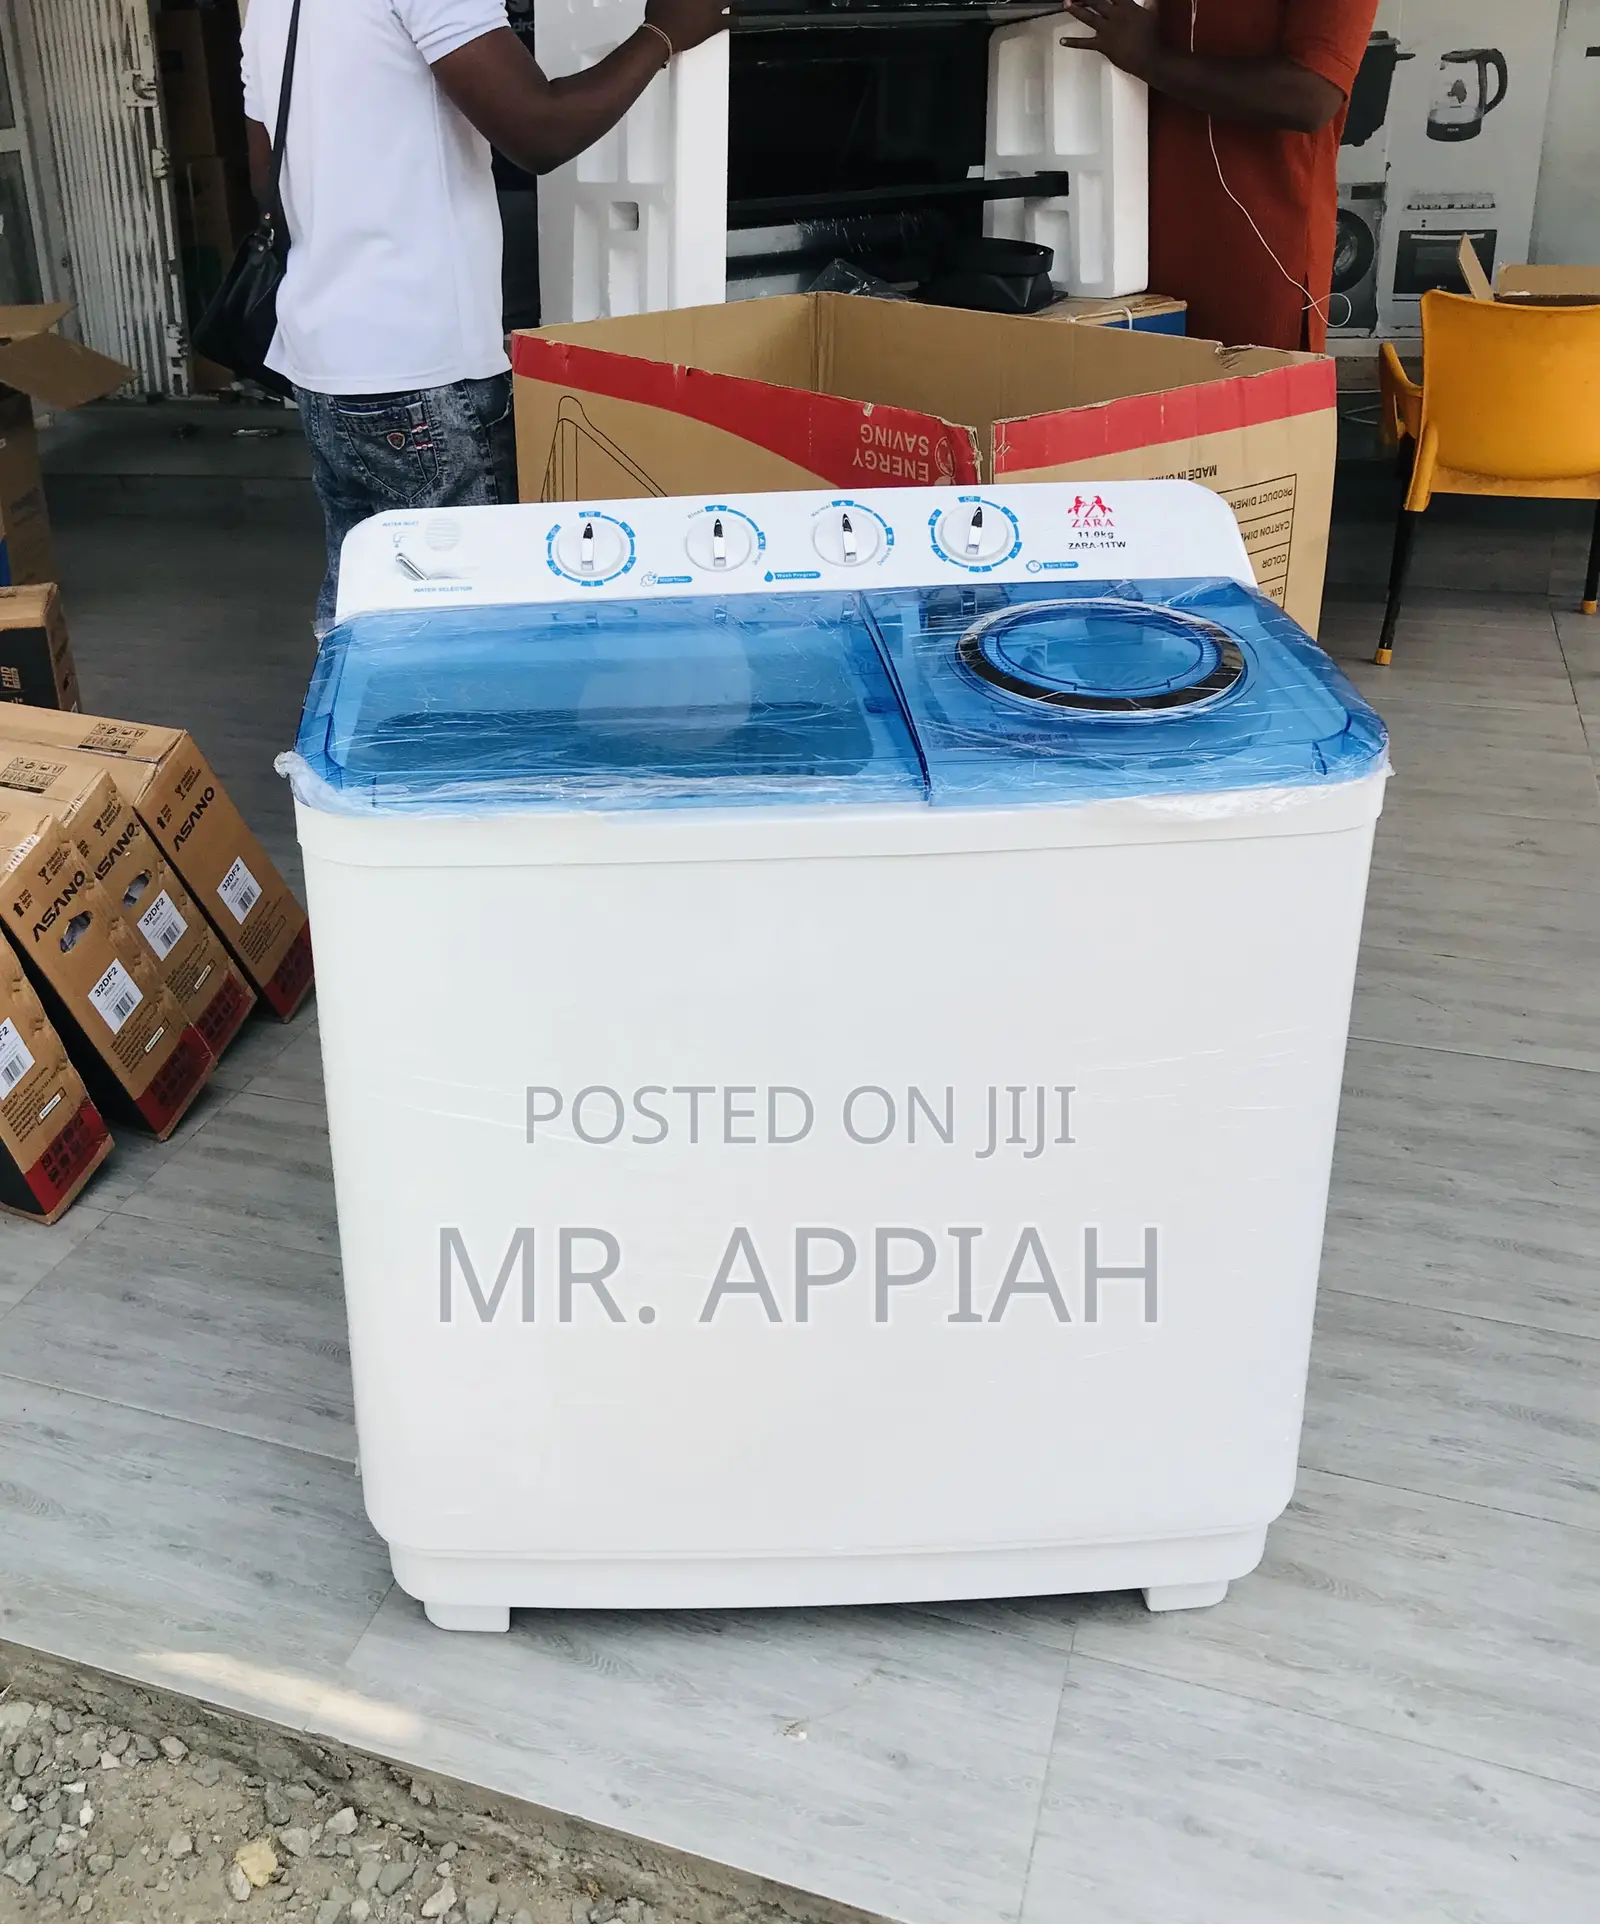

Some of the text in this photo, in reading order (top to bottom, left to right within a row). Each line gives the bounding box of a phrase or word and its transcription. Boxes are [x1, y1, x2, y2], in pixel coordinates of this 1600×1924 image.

[860, 424, 929, 456] SAVING
[852, 448, 929, 482] ENERGY
[1188, 465, 1217, 480] MADE
[1258, 488, 1293, 504] PRODUCT
[1071, 518, 1115, 528] ZARA
[1260, 521, 1290, 537] CARTON
[1068, 541, 1126, 549] ZARA-11TW
[1077, 531, 1114, 539] 11.0kg
[1262, 554, 1287, 569] COLOR
[173, 786, 215, 852] ASANO
[222, 863, 241, 892] 32DF2
[33, 870, 86, 943] ASANO
[143, 897, 166, 926] 32DF2
[94, 966, 119, 998] 32DF2
